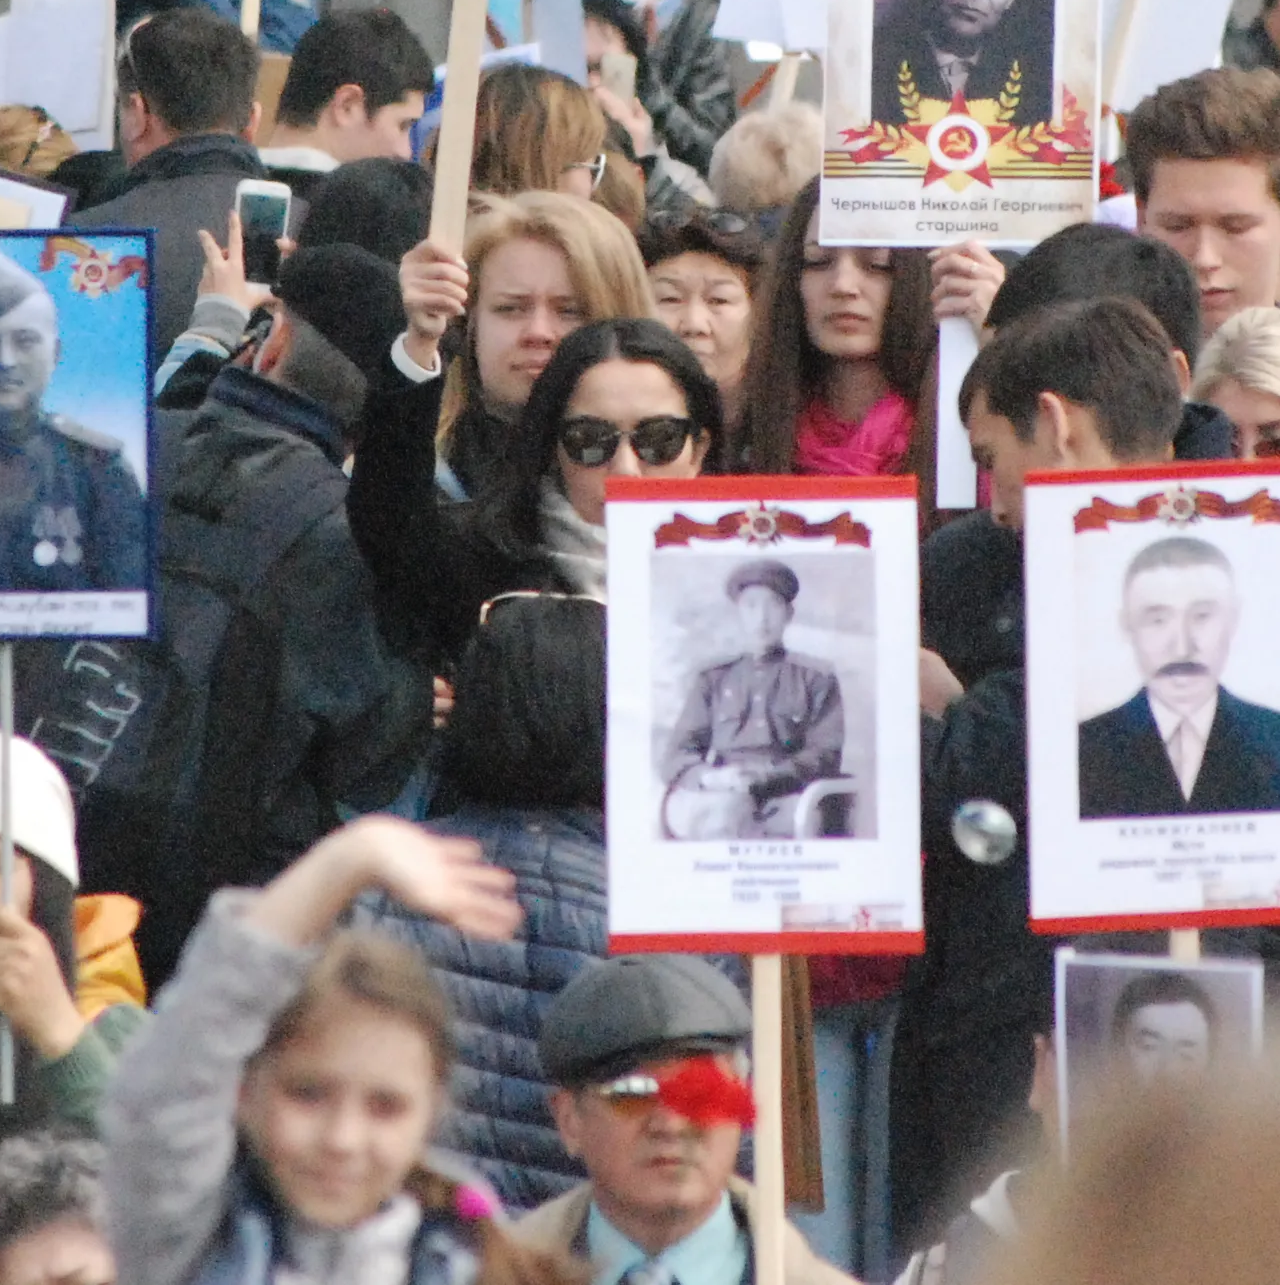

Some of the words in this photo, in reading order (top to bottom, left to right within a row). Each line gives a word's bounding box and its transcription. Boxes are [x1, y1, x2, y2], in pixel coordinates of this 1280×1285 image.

[830, 196, 917, 212] Чернышов
[920, 196, 988, 212] Николай
[915, 219, 1000, 234] старшина
